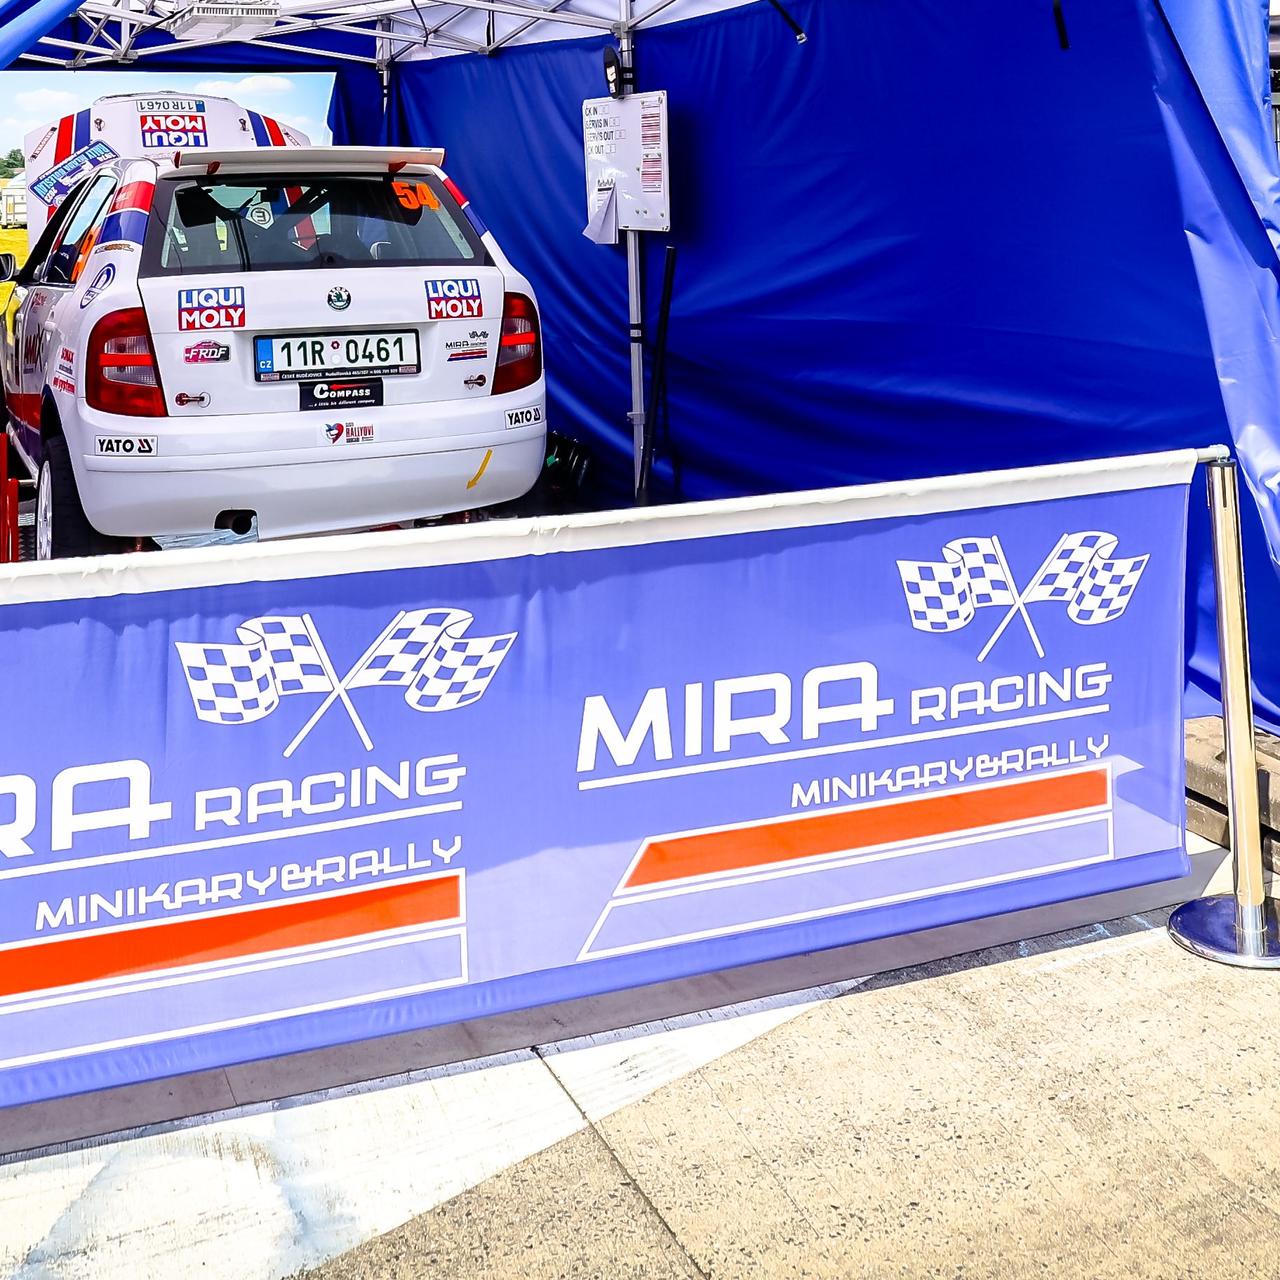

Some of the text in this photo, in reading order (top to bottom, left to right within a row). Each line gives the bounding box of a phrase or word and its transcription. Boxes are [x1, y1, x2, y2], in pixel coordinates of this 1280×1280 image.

[143, 116, 204, 130] MOLY
[144, 131, 206, 147] LIQUI
[392, 181, 440, 211] 54
[180, 288, 242, 308] LIQUI
[427, 280, 479, 298] LIQUI
[429, 299, 482, 318] MOLY
[181, 308, 244, 330] MOLY
[281, 337, 404, 368] 11R 0461
[260, 360, 272, 369] CZ
[507, 409, 532, 426] YATO
[98, 438, 135, 453] YATO
[577, 661, 1112, 772] MIRA RACING
[790, 734, 1111, 809] MINIKARY&RALLY
[194, 753, 467, 832] RACING
[34, 836, 462, 932] MINIKARY&RALLY
